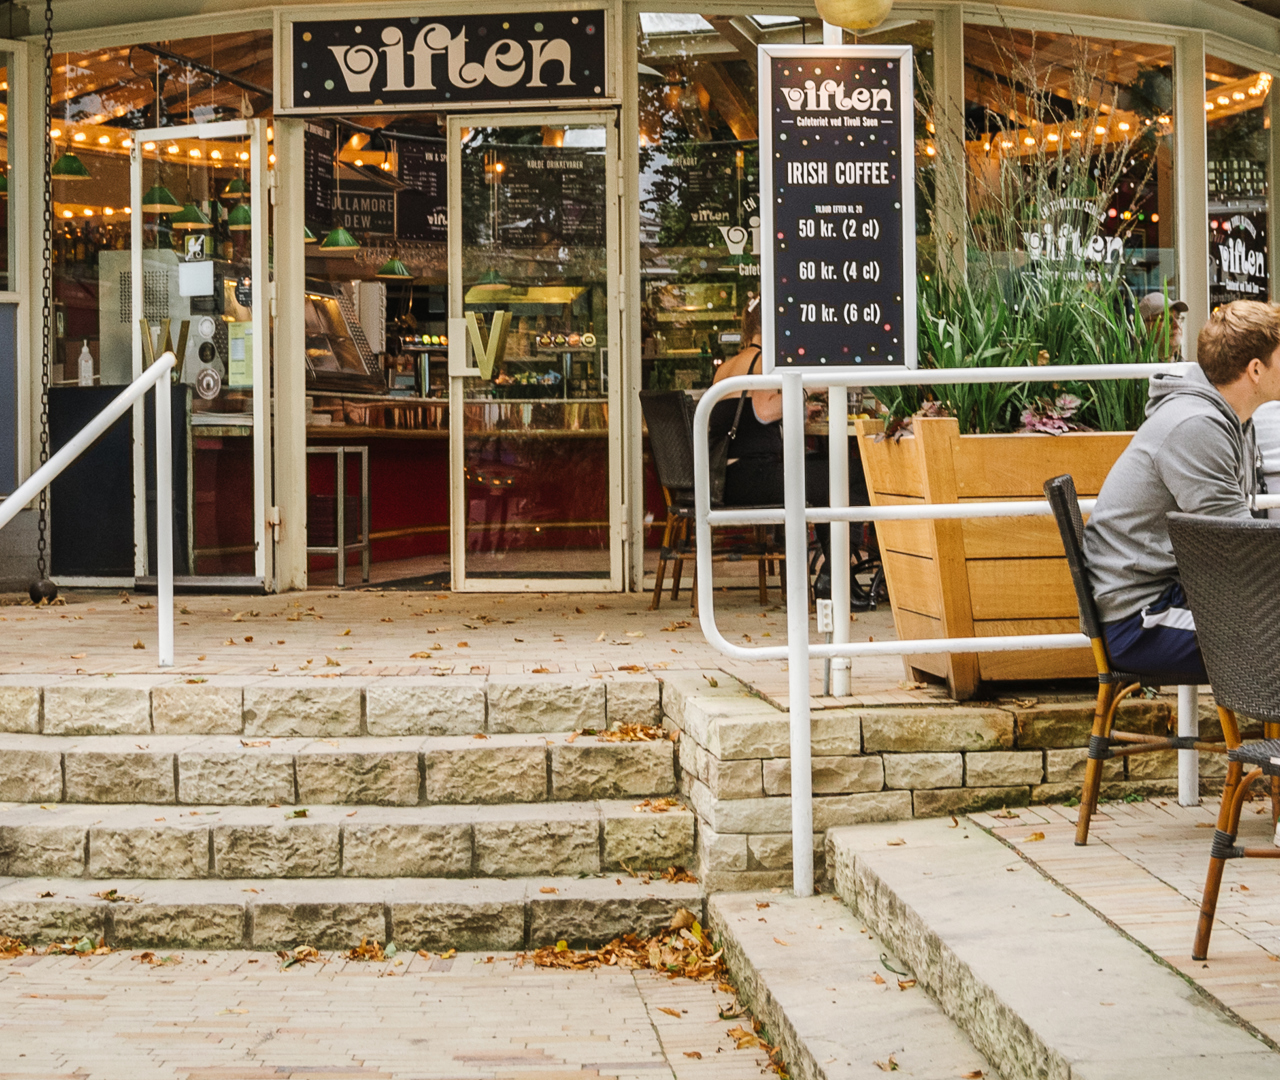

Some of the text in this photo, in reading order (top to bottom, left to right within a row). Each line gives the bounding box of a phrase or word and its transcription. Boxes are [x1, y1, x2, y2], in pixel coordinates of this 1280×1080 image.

[327, 23, 576, 93] viften
[780, 79, 893, 111] viften
[796, 116, 878, 127] Cafeteriet ved Tivoli Søen
[527, 160, 544, 169] KOLDE
[787, 162, 889, 184] IRISH COFFEE
[742, 197, 757, 212] EN
[799, 219, 879, 240] 50 kr. (2 cl)
[1218, 238, 1265, 277] viften
[799, 261, 880, 281] 60 kr. (4 cl)
[800, 303, 881, 325] 70 kr. (6 cl)
